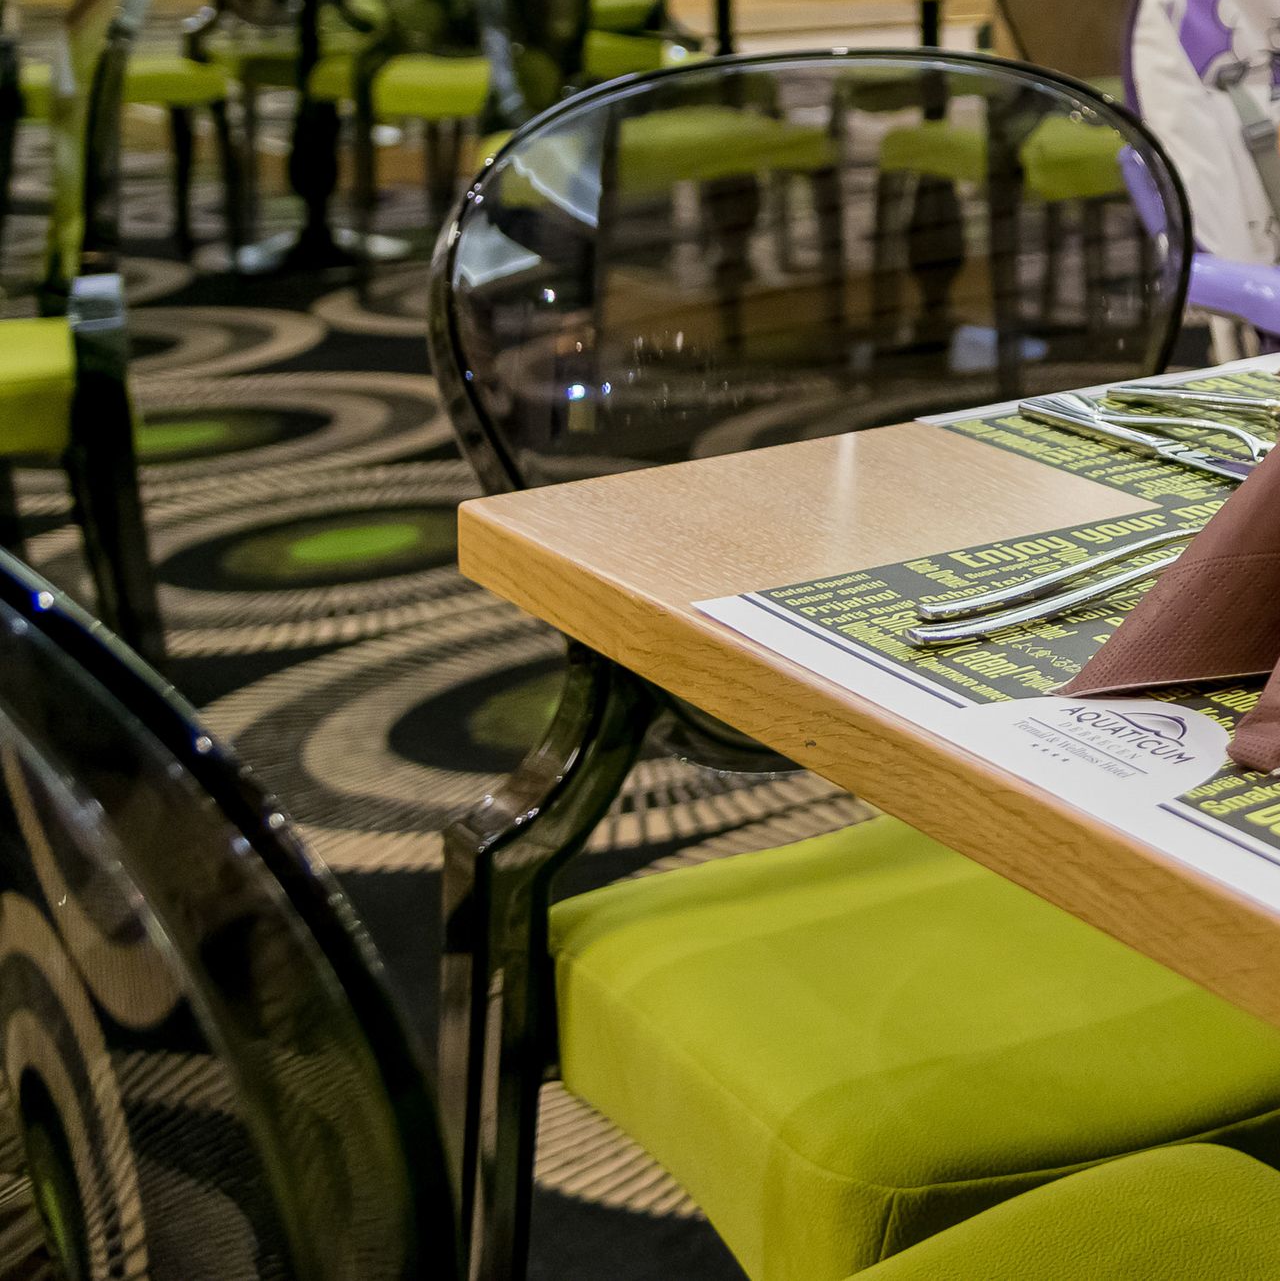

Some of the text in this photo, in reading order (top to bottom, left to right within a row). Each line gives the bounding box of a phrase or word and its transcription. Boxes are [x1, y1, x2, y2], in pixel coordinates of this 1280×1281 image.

[949, 535, 1082, 568] Enjoy
[1071, 513, 1166, 545] your
[800, 589, 901, 615] Prijatno!
[952, 649, 1035, 679] eten!
[1058, 721, 1143, 761] DEBRECEN
[1060, 706, 1196, 764] AQUATICUM
